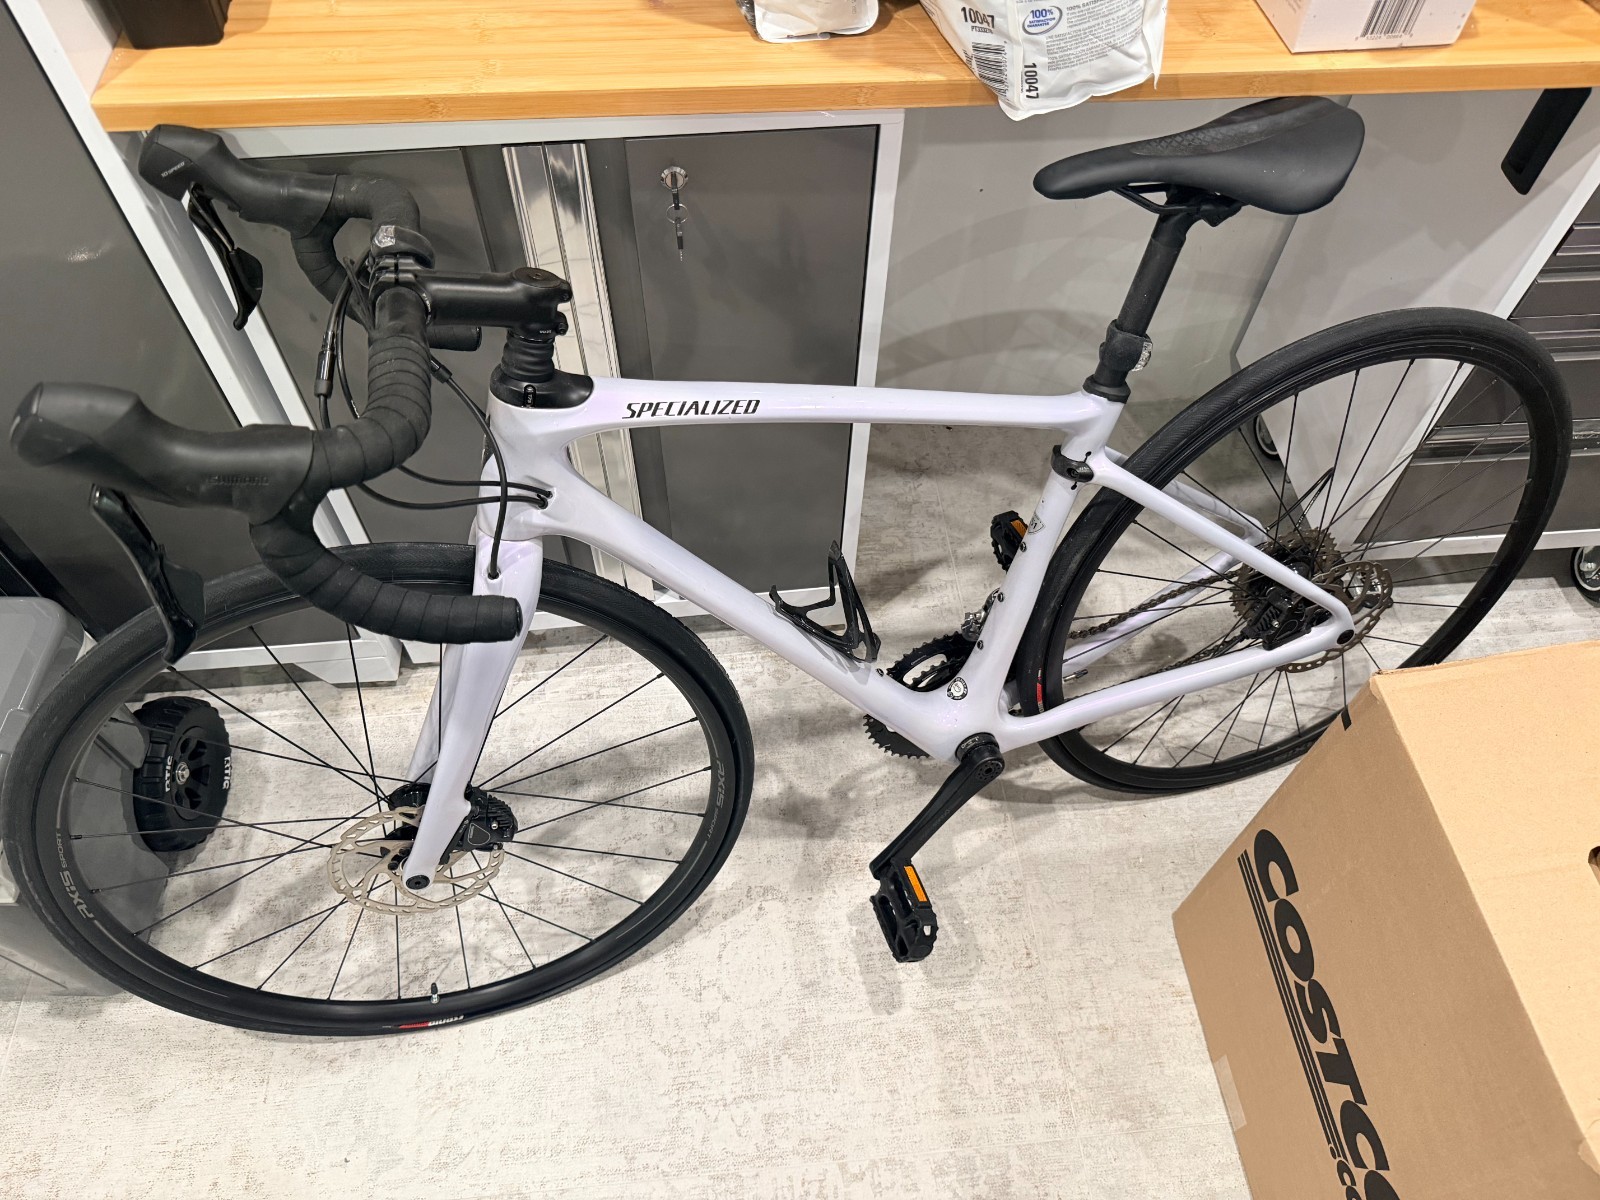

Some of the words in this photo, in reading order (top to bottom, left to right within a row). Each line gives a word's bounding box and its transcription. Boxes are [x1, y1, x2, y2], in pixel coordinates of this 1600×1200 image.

[961, 7, 995, 29] 10047
[1030, 8, 1054, 19] 100%
[1023, 62, 1040, 99] 10047
[621, 399, 761, 419] SPECIALIZED
[165, 755, 174, 793] RTIC
[222, 756, 233, 790] RTIC
